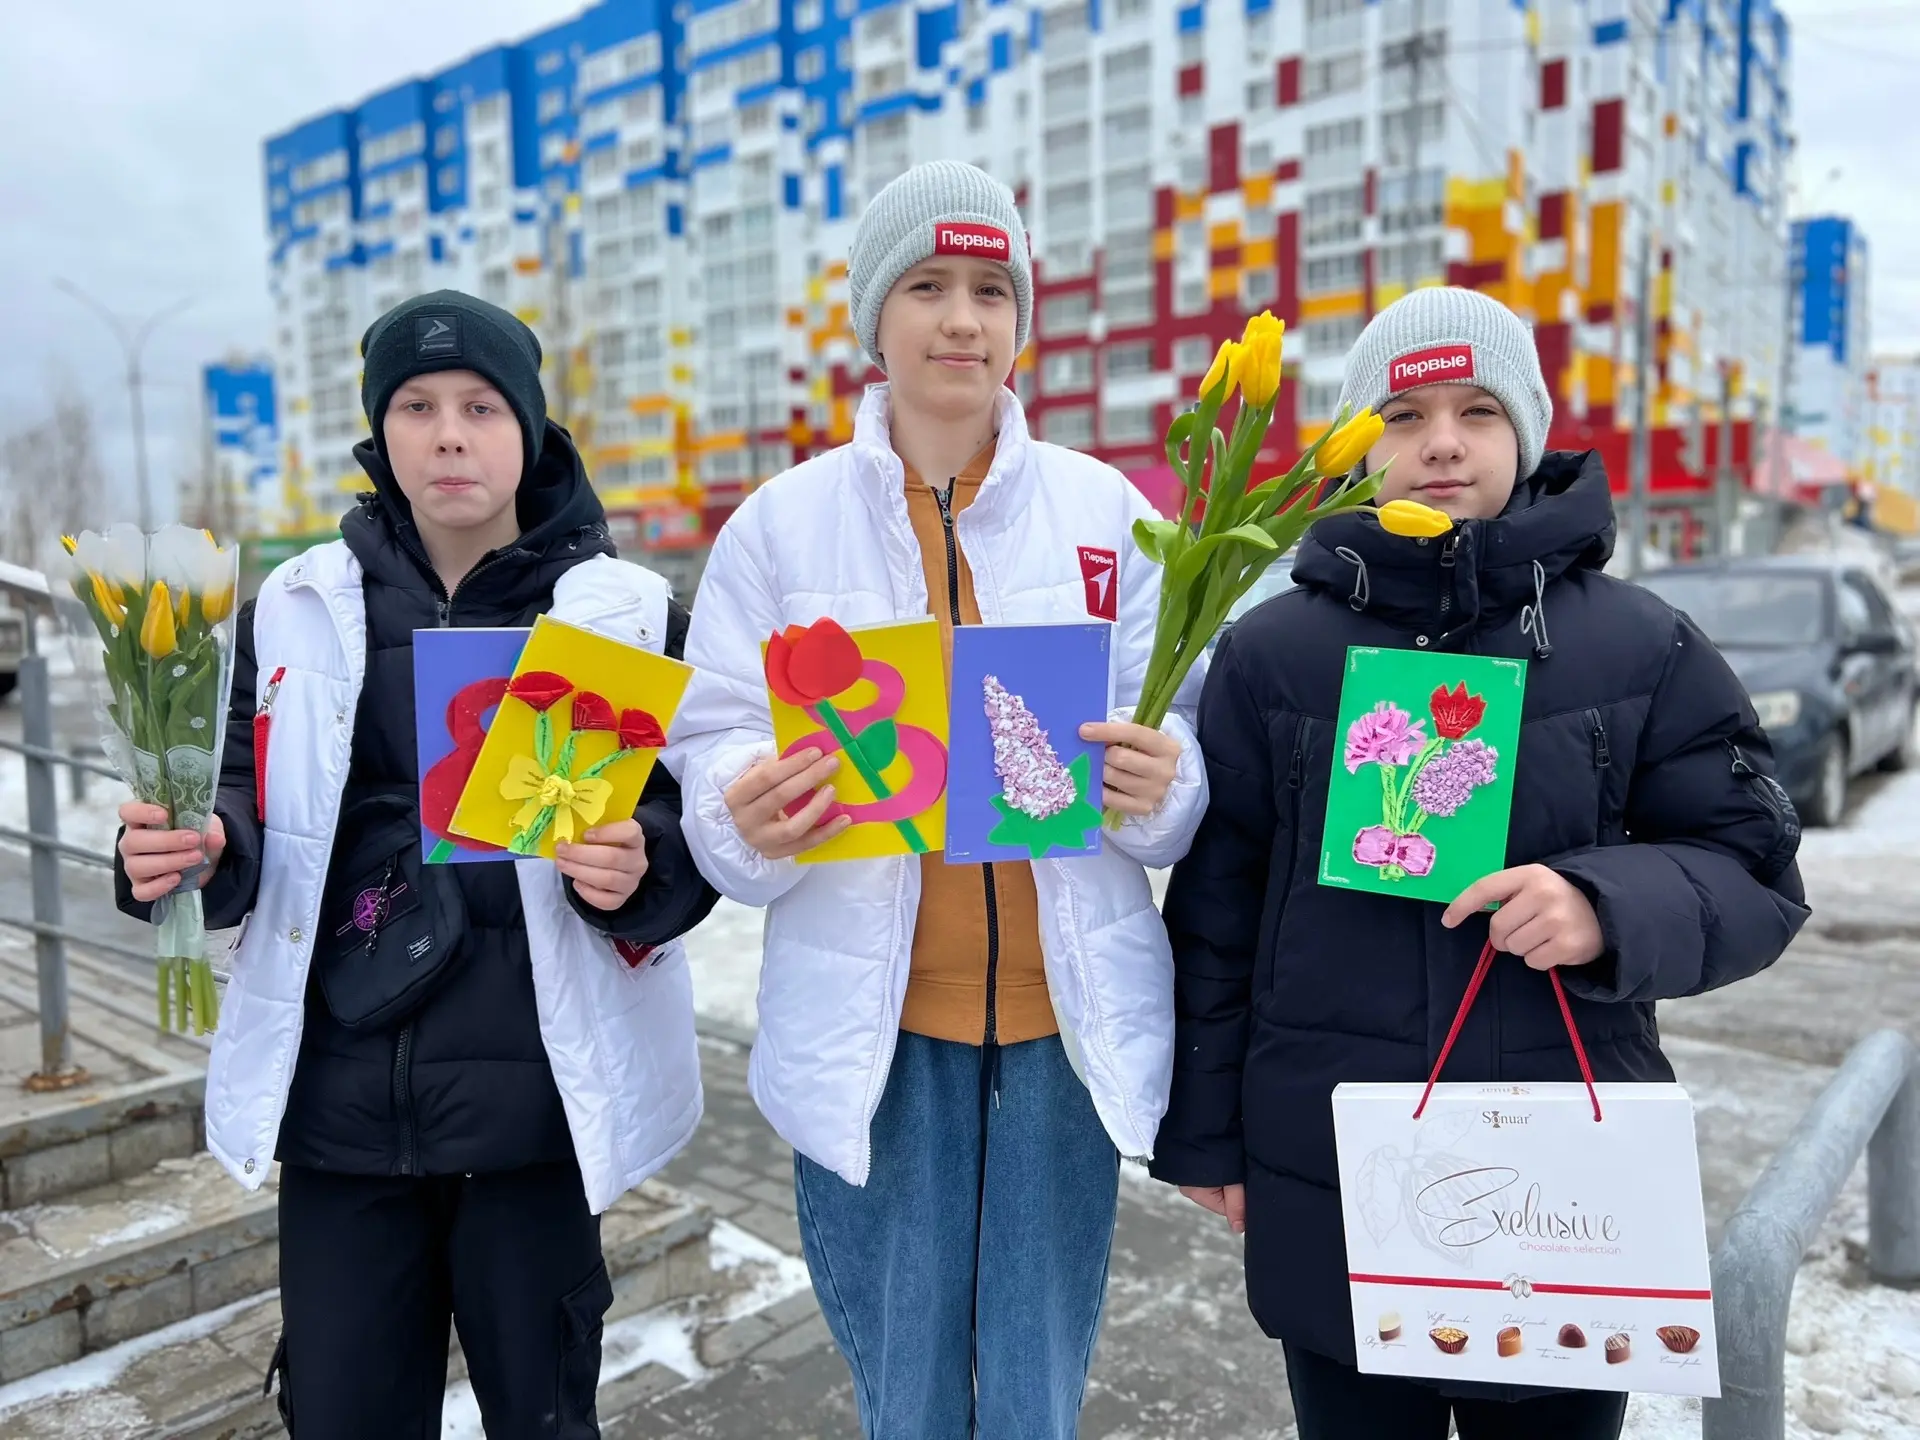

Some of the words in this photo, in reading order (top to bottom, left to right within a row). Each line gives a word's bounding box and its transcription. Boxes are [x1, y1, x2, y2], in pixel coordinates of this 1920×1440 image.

[942, 230, 1005, 250] Первые
[1395, 355, 1466, 379] Первые
[1083, 551, 1113, 565] Первые
[1416, 1167, 1620, 1247] Exclusive
[1519, 1241, 1571, 1253] Chocolate
[1574, 1243, 1621, 1255] selection
